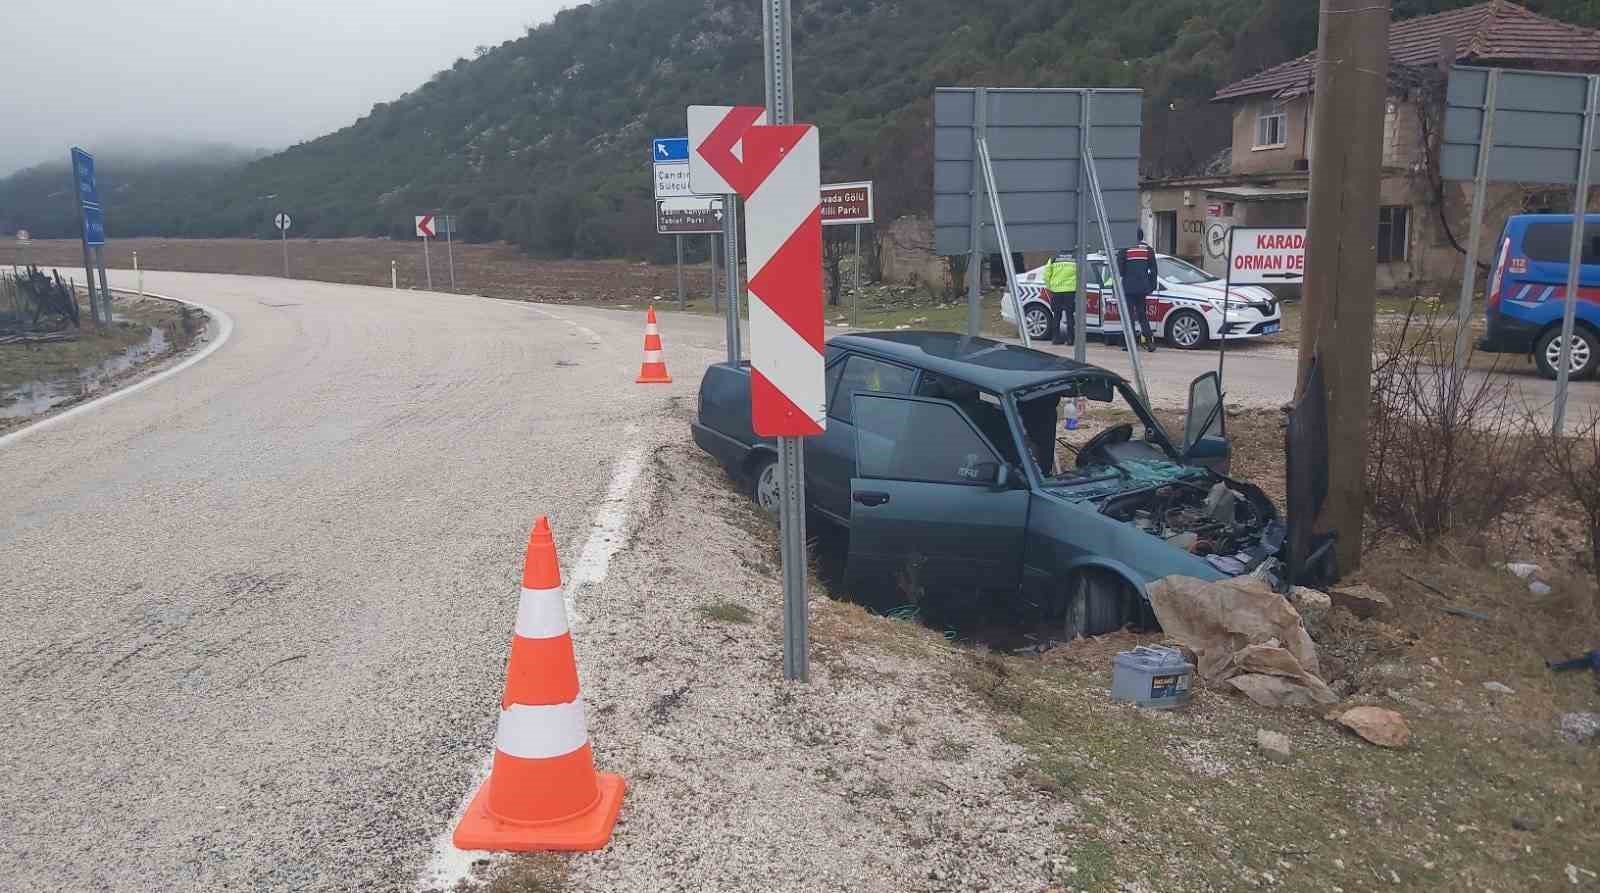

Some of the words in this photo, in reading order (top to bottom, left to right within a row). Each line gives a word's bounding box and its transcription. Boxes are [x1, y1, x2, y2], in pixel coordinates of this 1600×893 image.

[659, 182, 689, 191] Sütçü
[821, 193, 841, 203] vada
[1235, 255, 1281, 270] ORMAN
[1286, 255, 1303, 269] DE
[1512, 258, 1525, 267] 112
